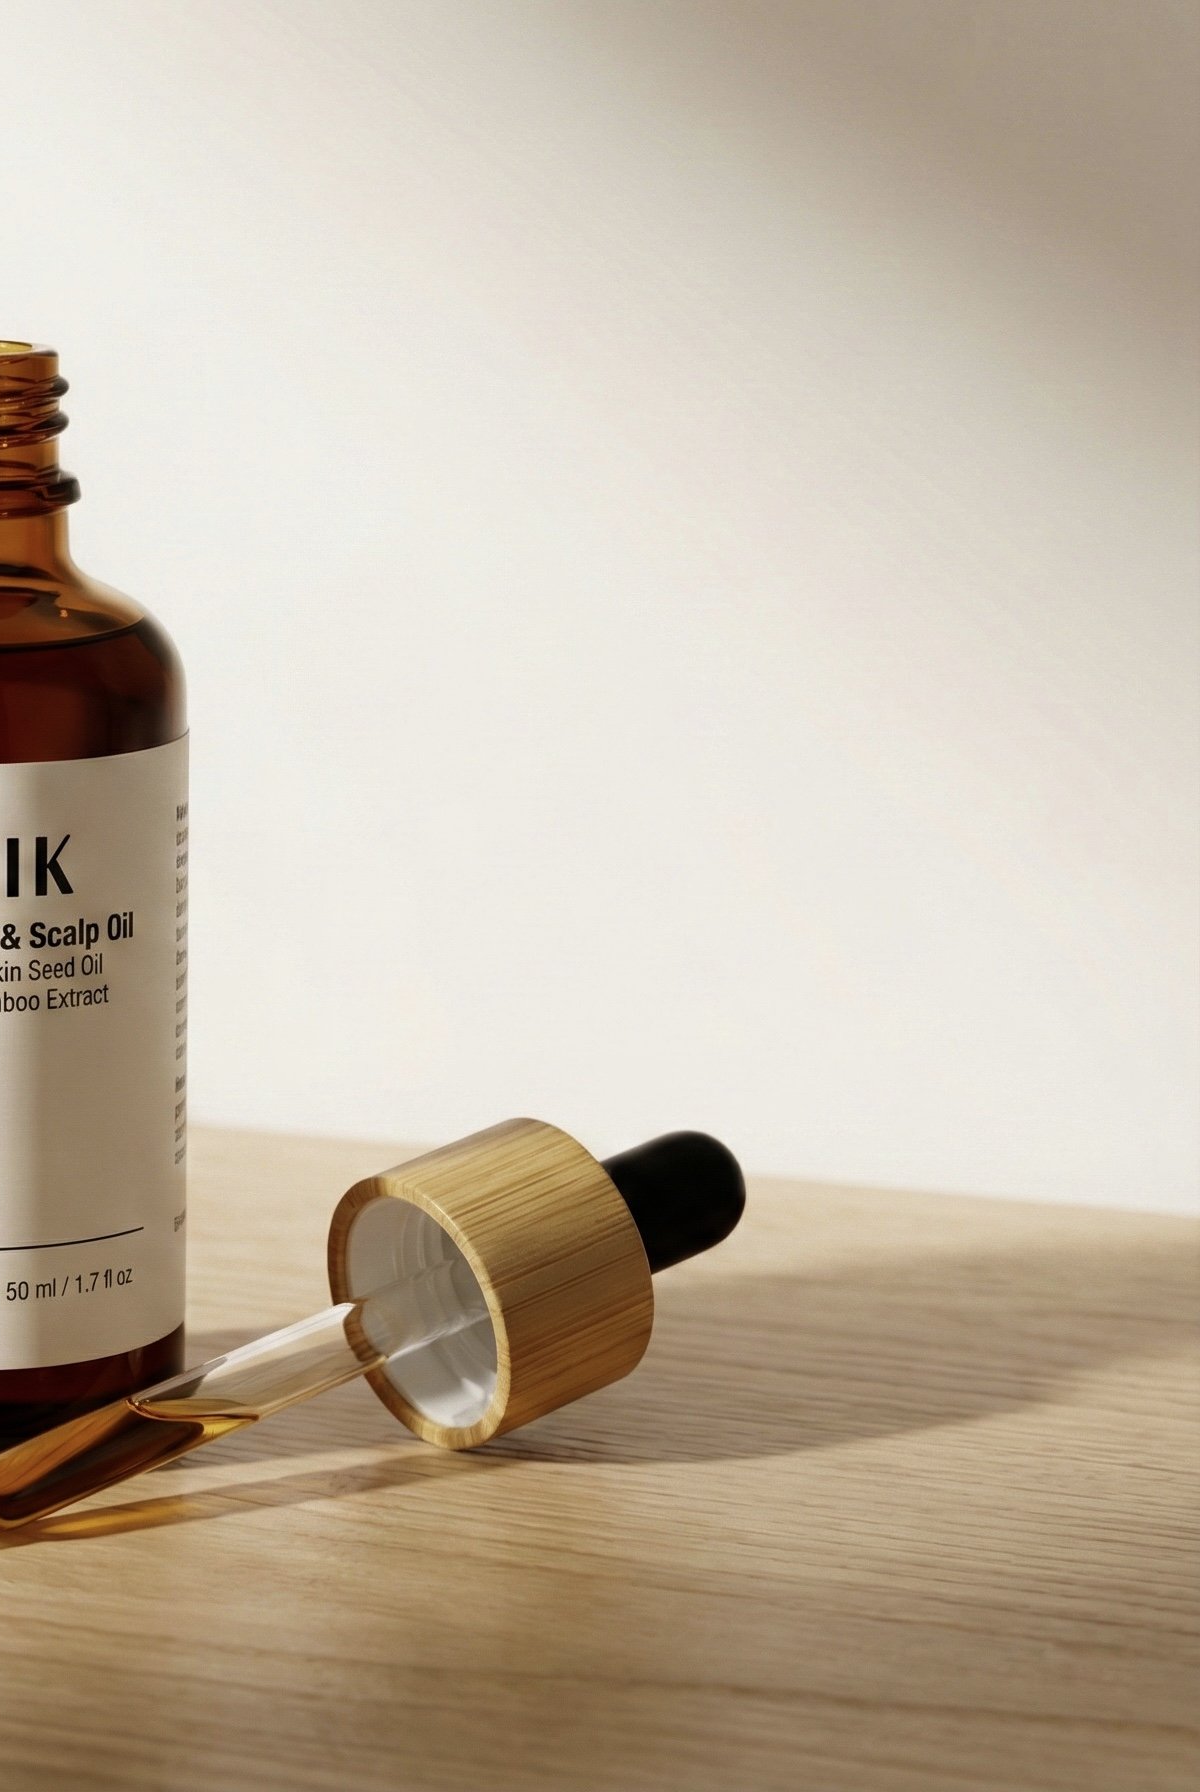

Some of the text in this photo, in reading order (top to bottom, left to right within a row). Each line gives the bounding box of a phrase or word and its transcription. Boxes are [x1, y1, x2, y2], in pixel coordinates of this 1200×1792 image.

[0, 923, 21, 951] &
[29, 917, 100, 951] Scalp
[107, 911, 134, 941] Oil
[28, 956, 75, 981] Seed
[81, 952, 103, 976] Oil
[47, 983, 109, 1010] Extract
[6, 1267, 133, 1302] 50 ml / 1.7 fl oz
